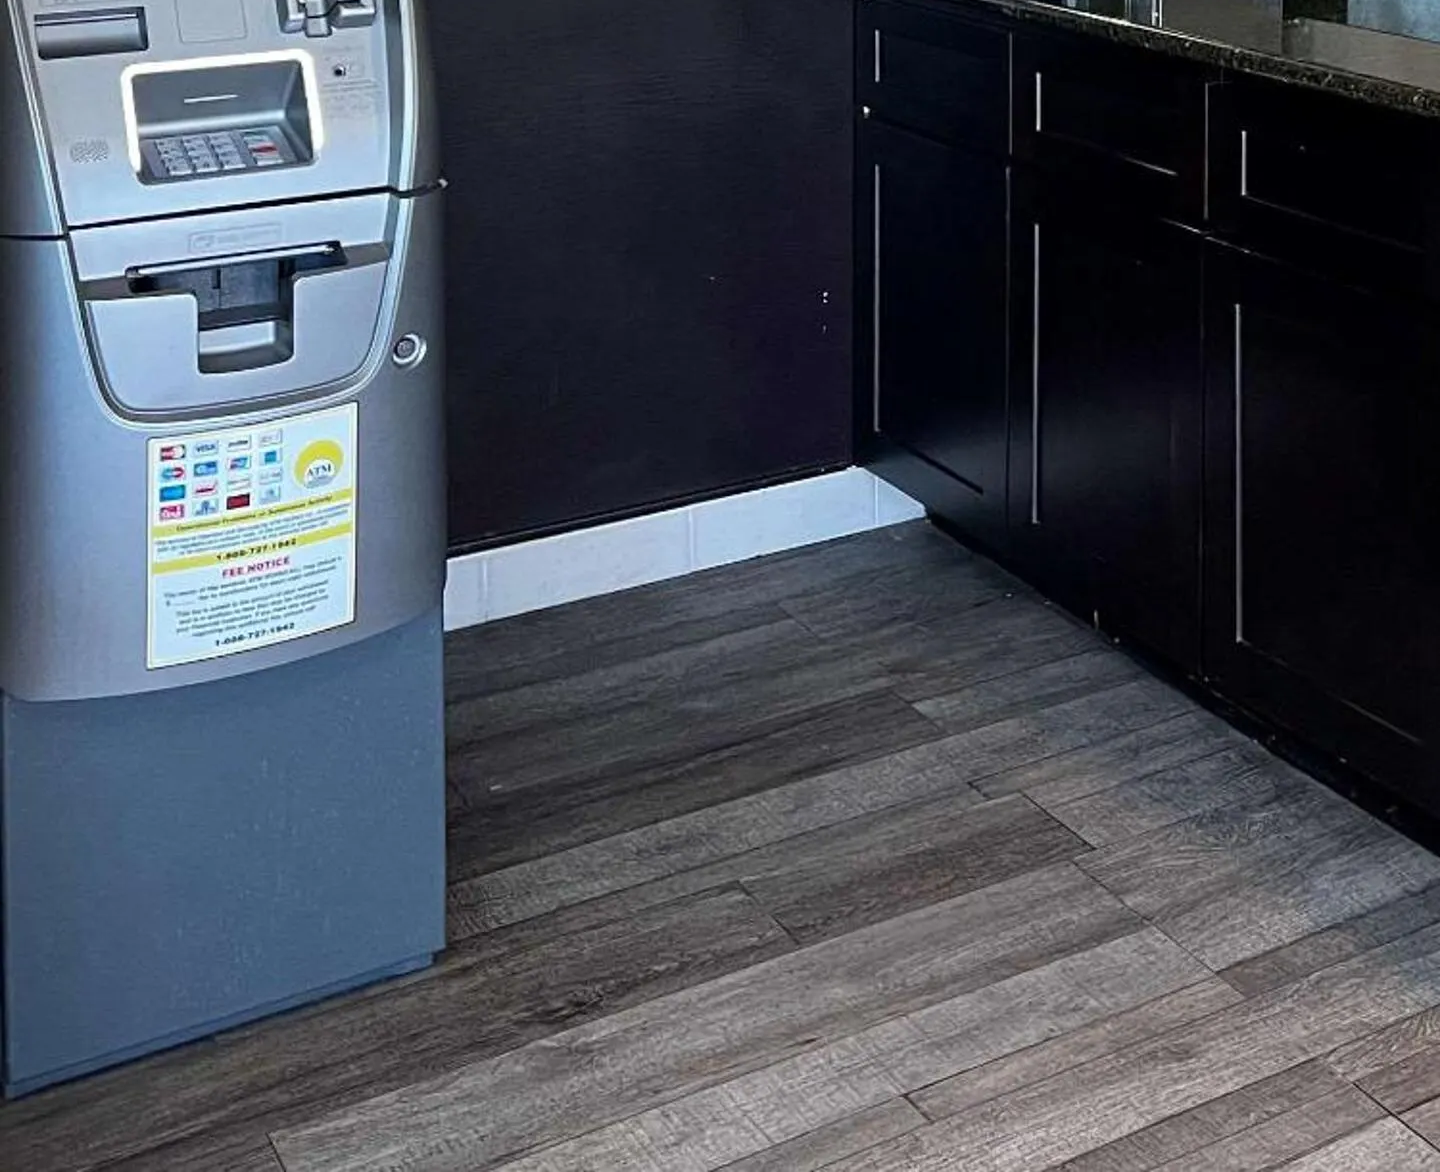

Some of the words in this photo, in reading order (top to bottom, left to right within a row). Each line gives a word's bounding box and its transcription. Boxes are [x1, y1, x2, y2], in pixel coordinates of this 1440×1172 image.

[306, 463, 333, 477] ATM
[221, 566, 244, 578] FEE
[246, 556, 291, 575] NOTICE
